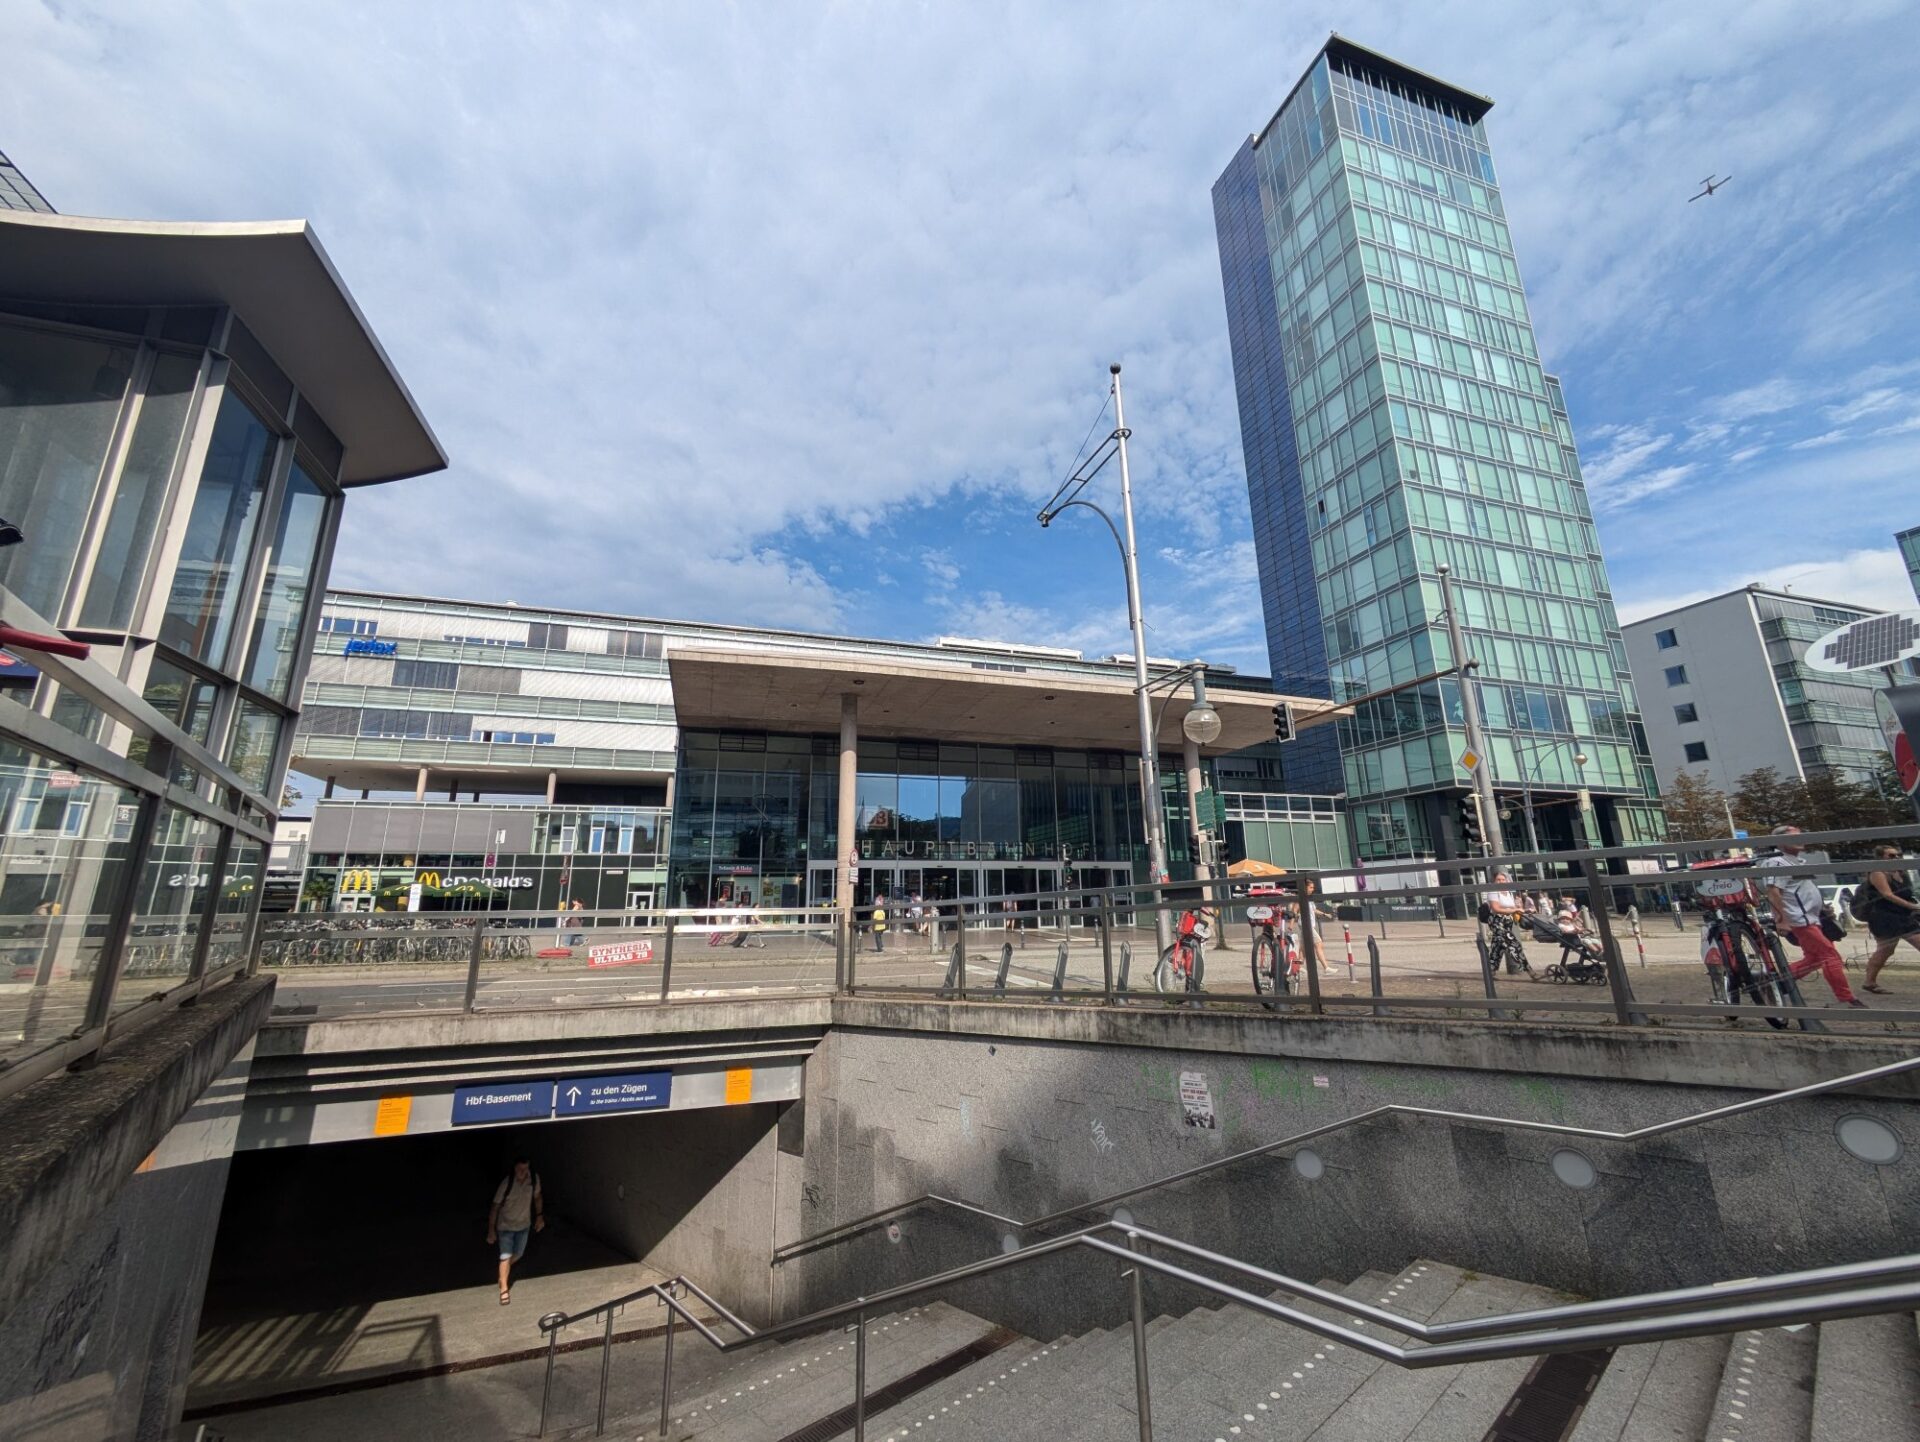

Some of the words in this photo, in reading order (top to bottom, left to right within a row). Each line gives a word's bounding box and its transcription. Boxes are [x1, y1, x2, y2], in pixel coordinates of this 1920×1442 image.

[592, 943, 649, 956] SYNTHESIA
[594, 952, 633, 964] ULTRAS
[591, 1088, 601, 1096] zu
[603, 1086, 619, 1094] den
[621, 1084, 647, 1095] Zügen
[465, 1092, 532, 1106] Hbf-Basement
